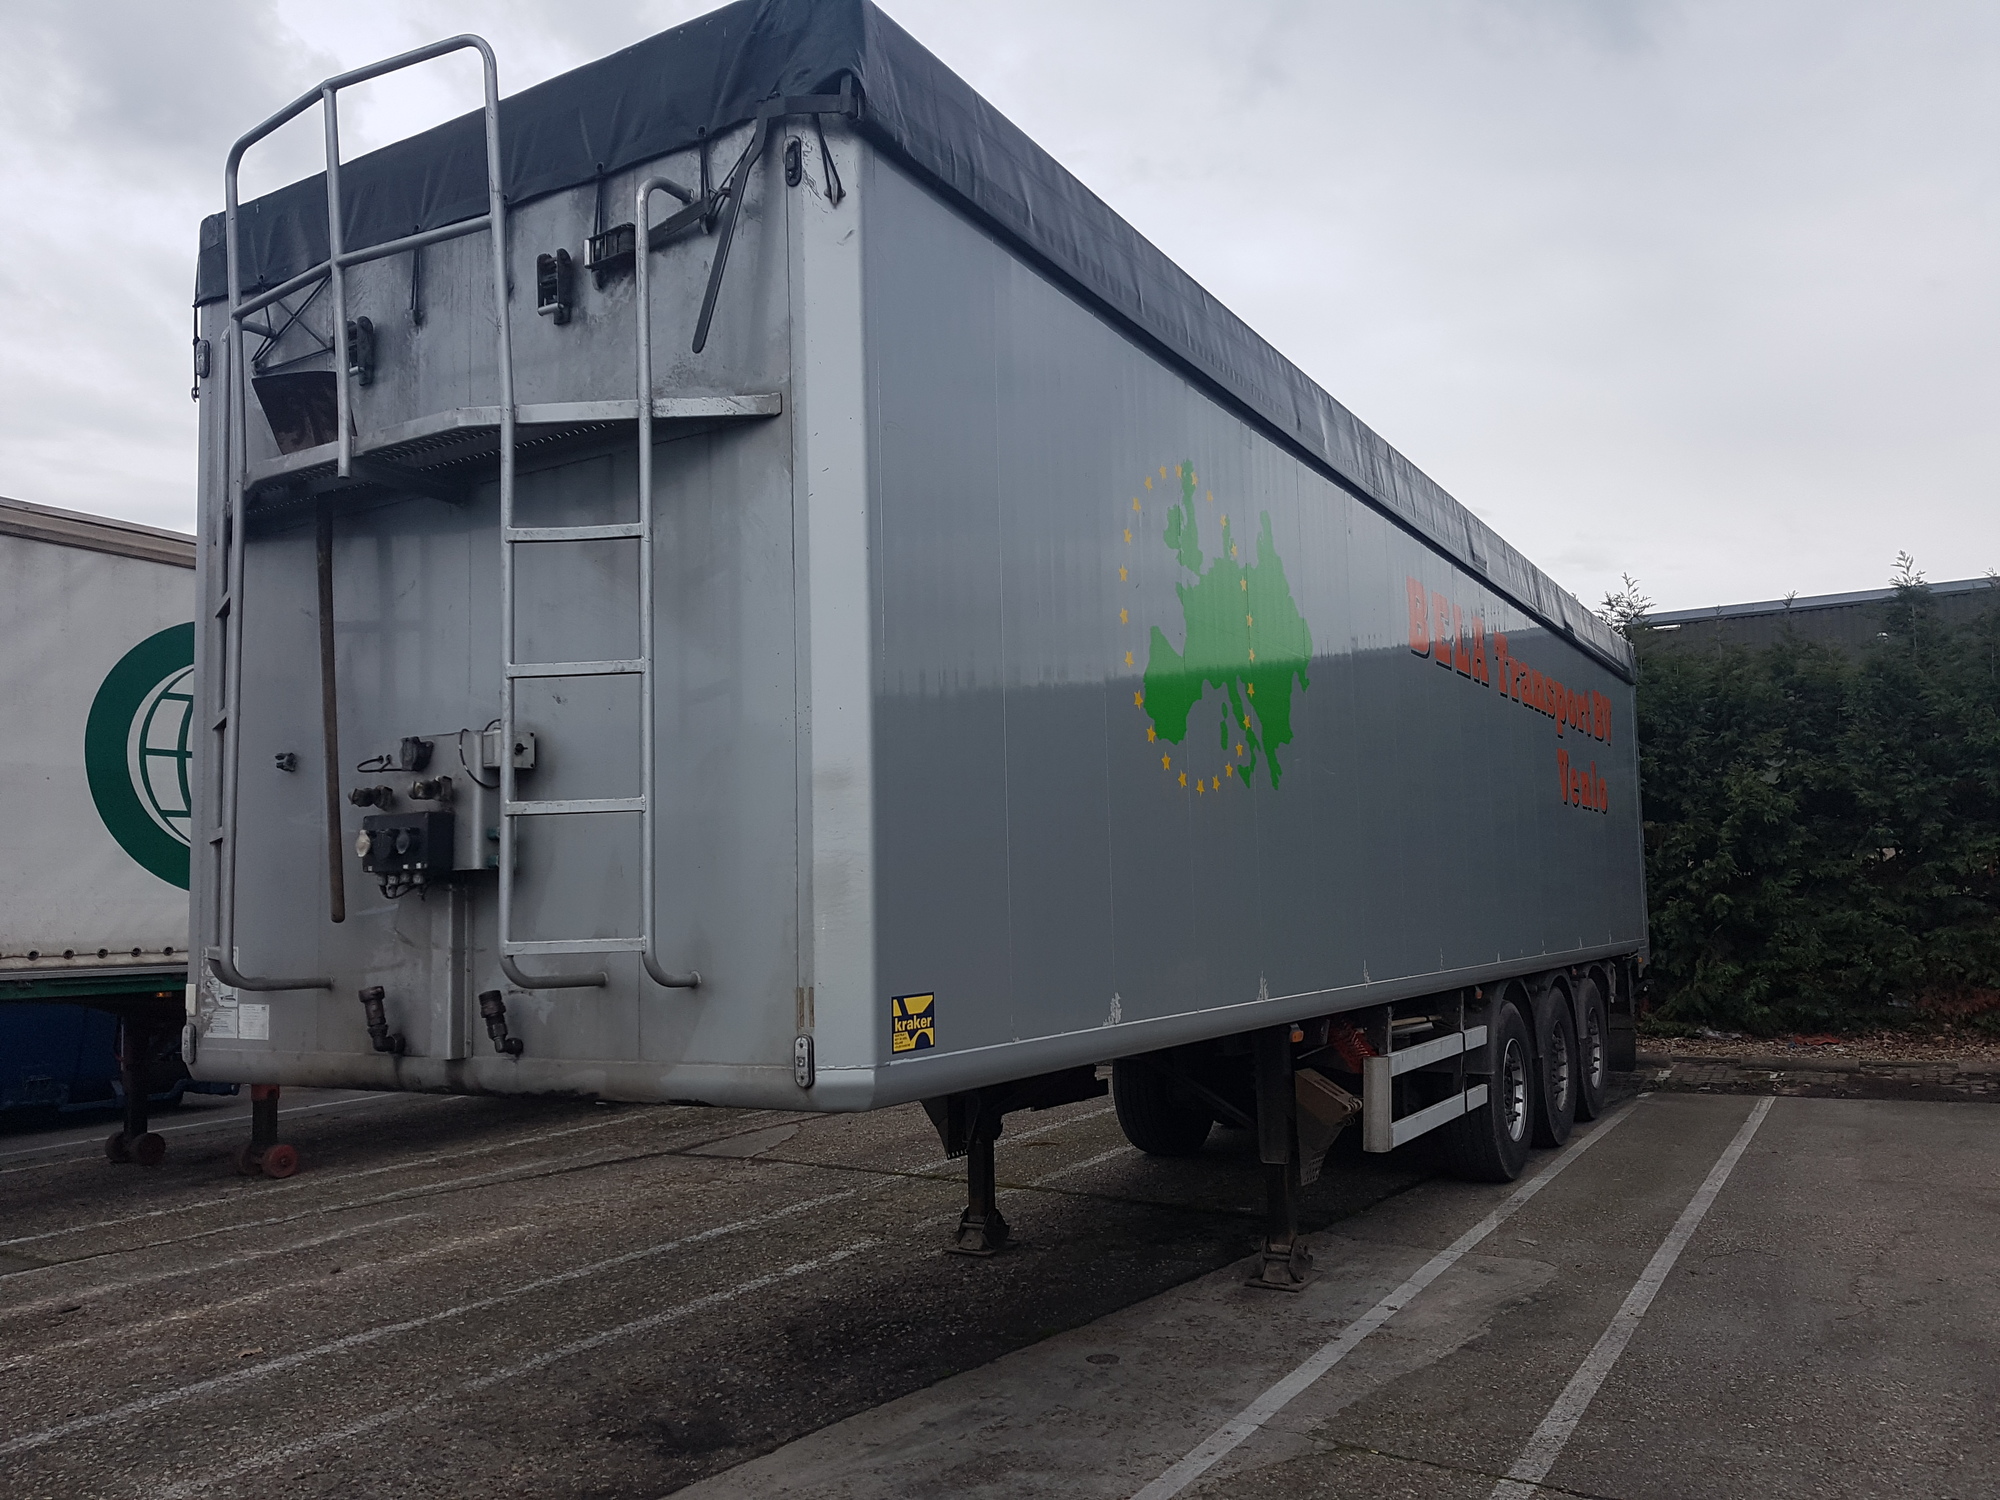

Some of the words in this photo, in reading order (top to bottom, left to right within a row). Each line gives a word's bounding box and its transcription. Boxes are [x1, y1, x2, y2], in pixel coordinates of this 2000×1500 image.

[1406, 575, 1489, 688] BELA
[1494, 631, 1592, 739] Transport
[1557, 748, 1608, 815] Venlo
[894, 1015, 932, 1032] kraker
